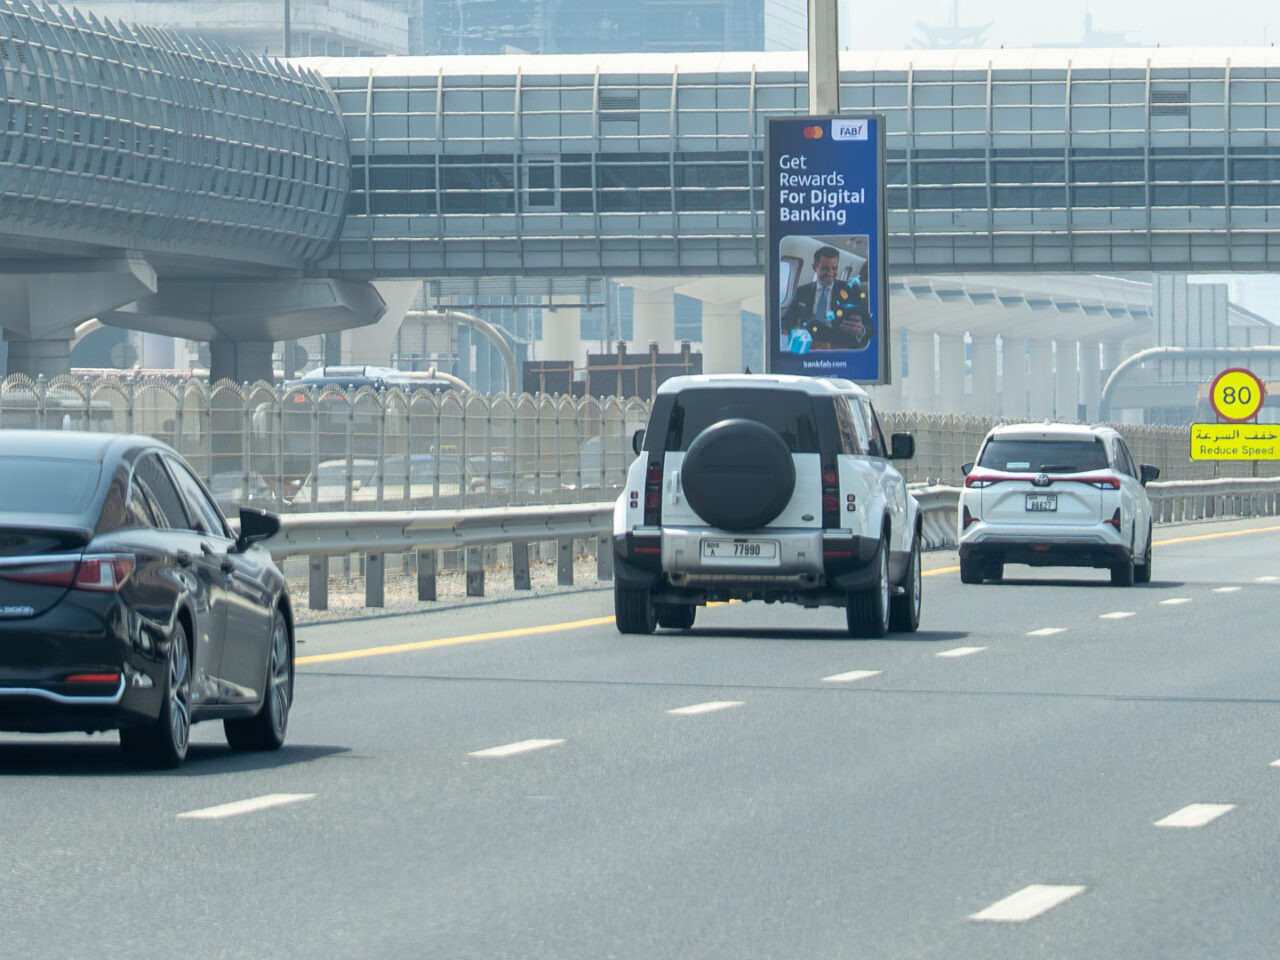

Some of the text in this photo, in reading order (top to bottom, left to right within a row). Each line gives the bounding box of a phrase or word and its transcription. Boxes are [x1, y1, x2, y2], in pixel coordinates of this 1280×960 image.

[840, 127, 857, 136] FAB
[780, 154, 807, 169] Get
[780, 171, 845, 187] Rewards
[780, 188, 865, 208] For Digital
[780, 207, 847, 225] Banking
[1223, 386, 1252, 405] 80
[1196, 428, 1278, 442] خفف السرعة
[1200, 444, 1275, 456] Reduce Speed
